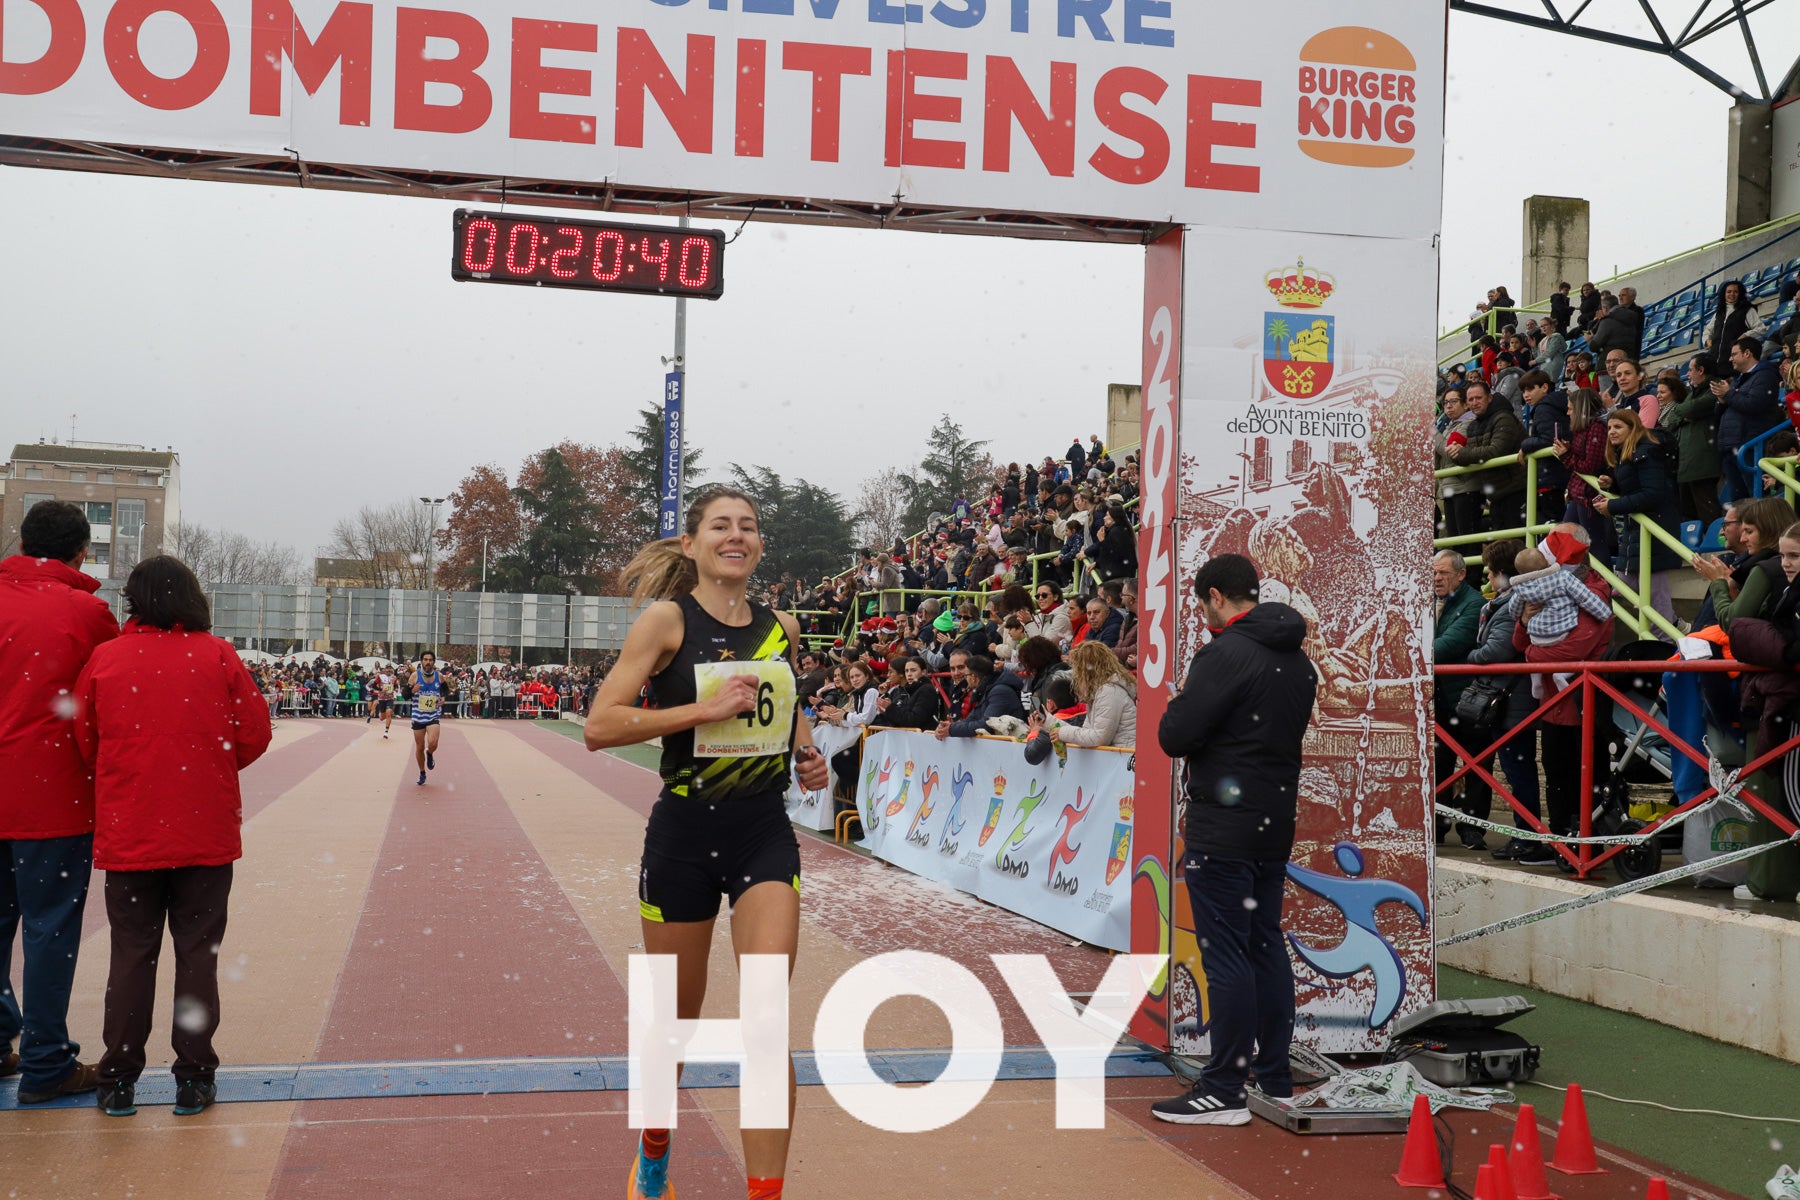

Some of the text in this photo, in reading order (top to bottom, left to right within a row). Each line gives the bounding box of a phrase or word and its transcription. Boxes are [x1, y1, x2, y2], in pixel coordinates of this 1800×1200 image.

[0, 0, 1261, 193] DOMBENITENSE
[1299, 66, 1416, 103] BURGER
[1298, 96, 1416, 144] KING
[464, 220, 710, 287] 00:20:40
[1246, 403, 1363, 424] Ayuntamiento
[1300, 421, 1366, 439] BENITO
[1142, 305, 1173, 689] 2023
[424, 698, 433, 708] 42
[1002, 854, 1029, 879] DMD
[1053, 870, 1079, 895] DMD
